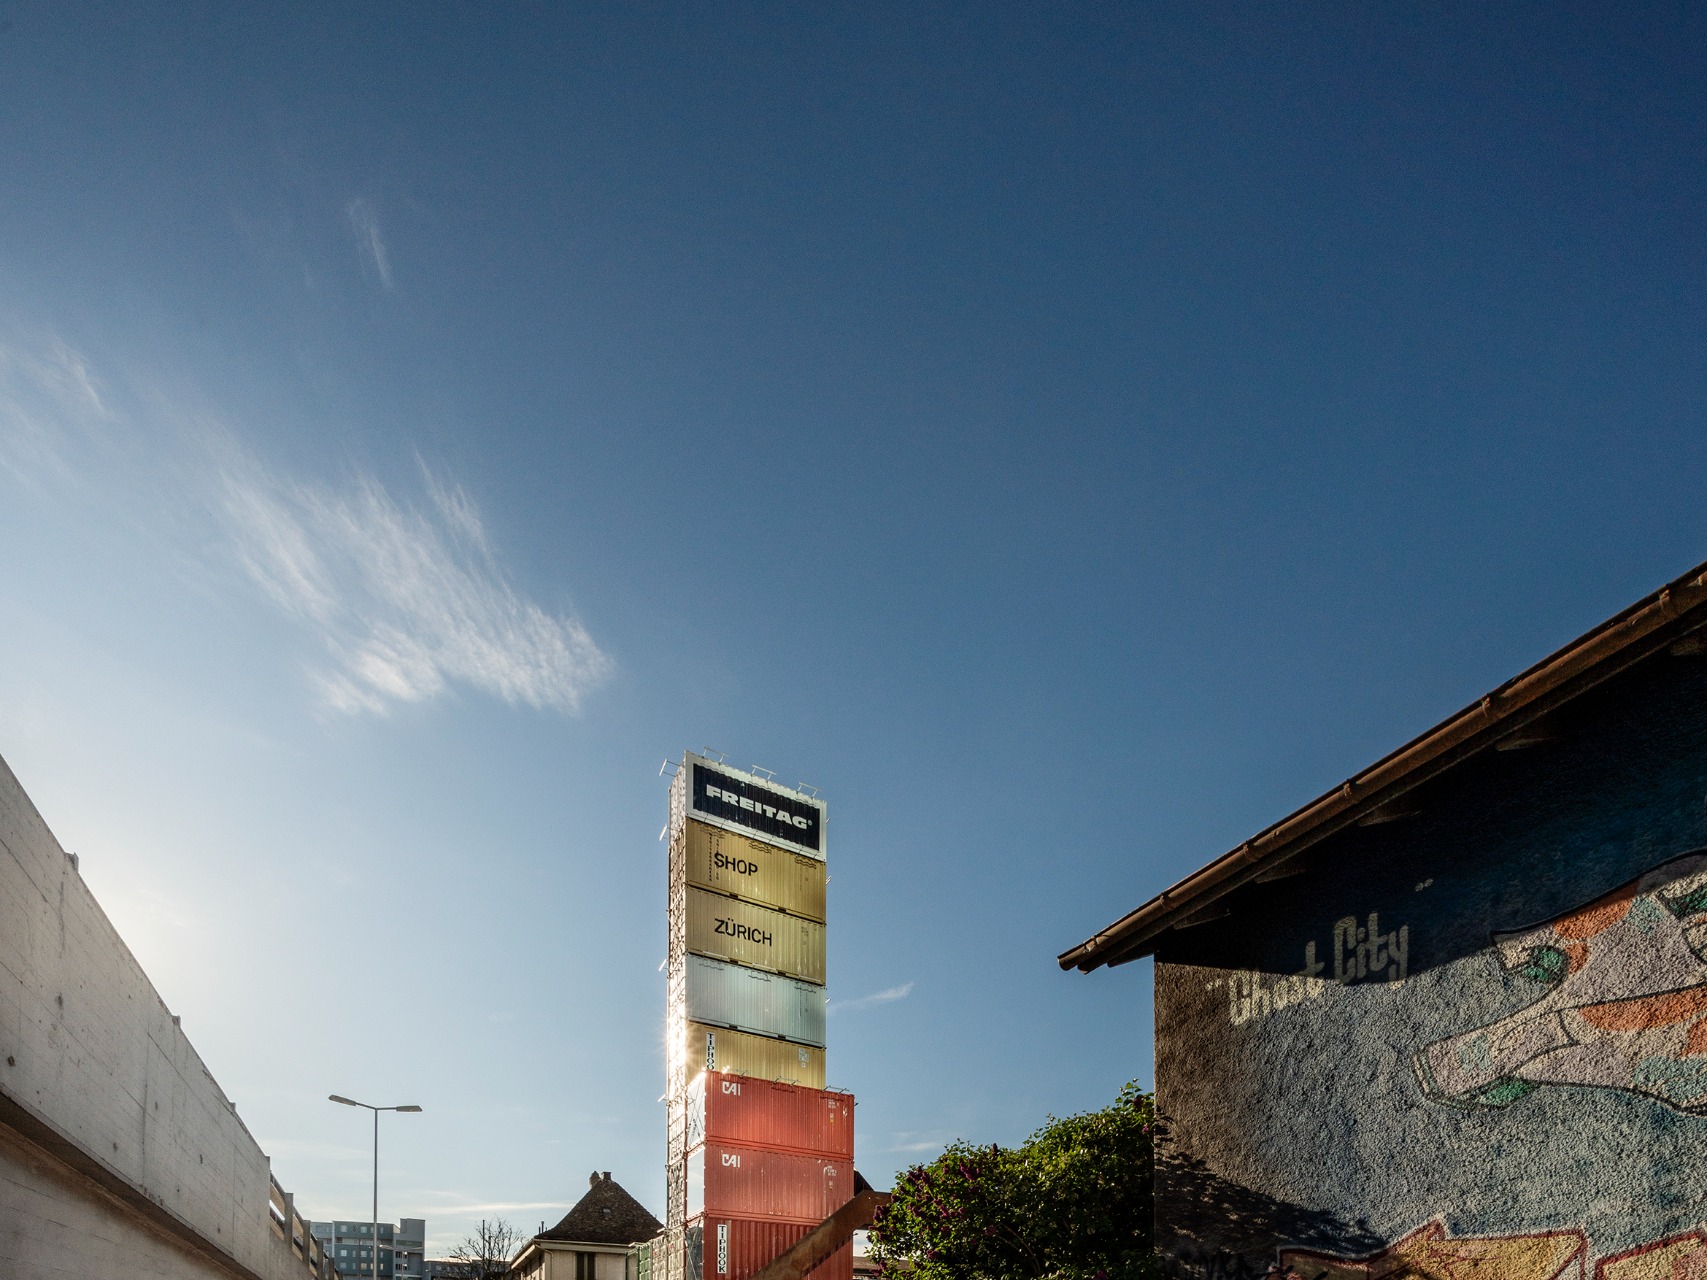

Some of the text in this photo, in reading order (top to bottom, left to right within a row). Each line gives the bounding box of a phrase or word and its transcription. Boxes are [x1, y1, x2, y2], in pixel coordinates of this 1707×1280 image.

[714, 852, 758, 876] SHOP
[714, 917, 772, 947] ZÜRICH
[706, 1032, 715, 1070] TIPHOO
[718, 1225, 726, 1273] TIPHOOK
